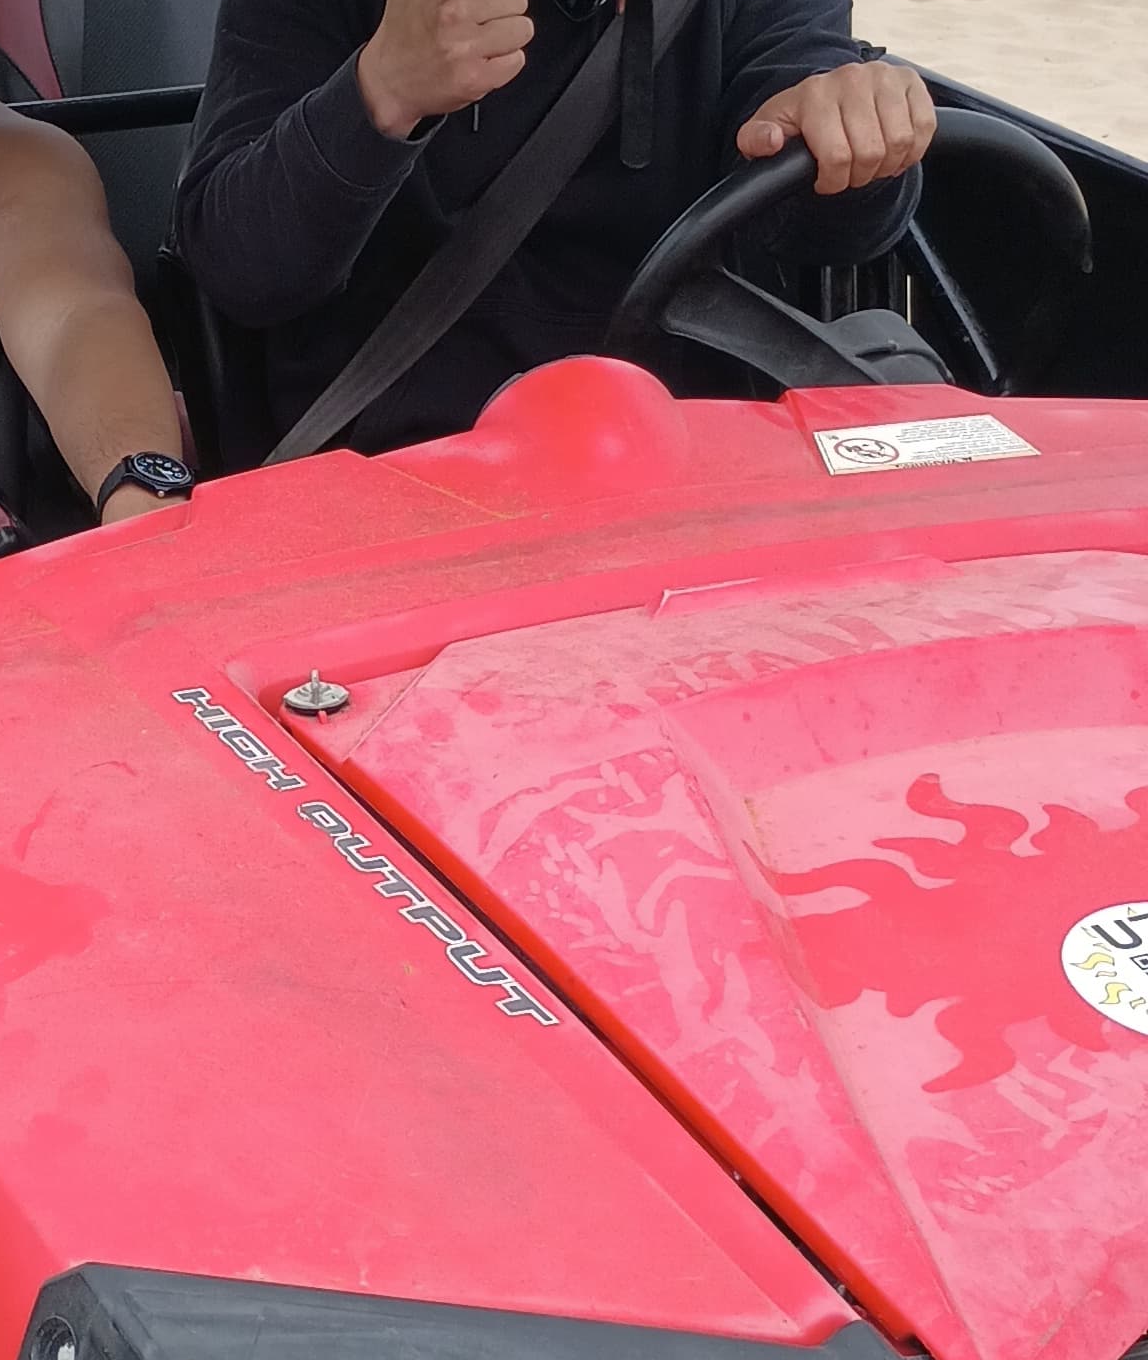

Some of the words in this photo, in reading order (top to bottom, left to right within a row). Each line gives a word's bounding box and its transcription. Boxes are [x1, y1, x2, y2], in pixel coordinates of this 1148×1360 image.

[172, 686, 306, 792] HIGH
[297, 801, 560, 1027] OUTPUT
[1090, 912, 1148, 950] U
